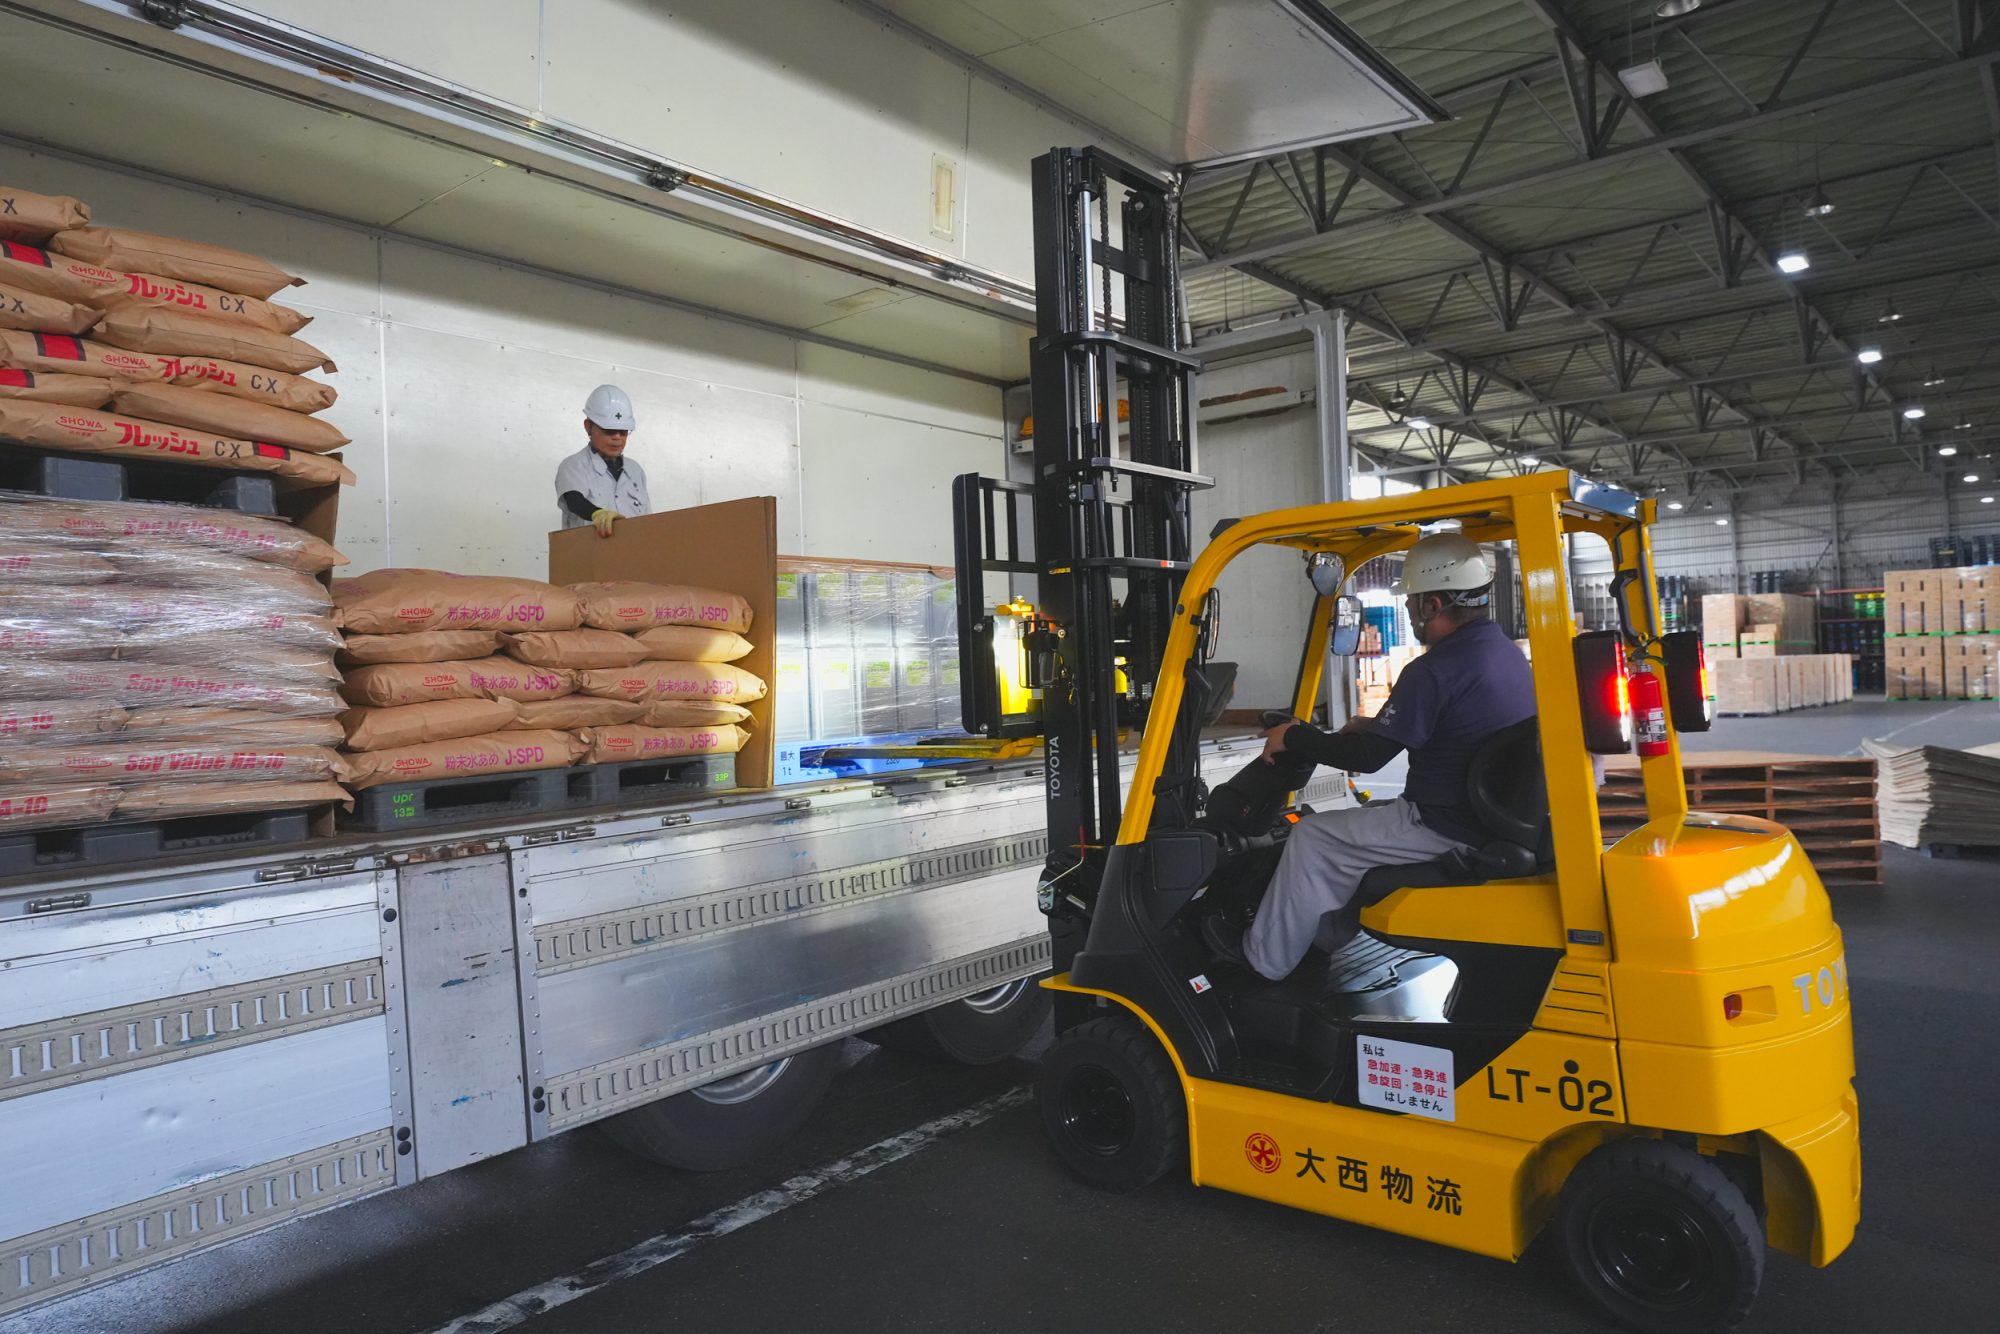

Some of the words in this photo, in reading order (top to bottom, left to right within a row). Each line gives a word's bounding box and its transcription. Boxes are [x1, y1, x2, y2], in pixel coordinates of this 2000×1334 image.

[71, 265, 113, 280] SHOWA
[123, 273, 208, 310] フレッシュ
[104, 354, 147, 366] SHOWA
[157, 357, 237, 387] フレッシュ
[59, 416, 104, 430] SHOWA
[114, 422, 201, 456] フレッシュ
[400, 607, 433, 616] SHOWA
[447, 605, 501, 621] 粉末水あめ
[506, 604, 545, 622] J-SPD
[618, 607, 643, 615] SHOWA
[699, 606, 728, 622] J-SPD
[424, 674, 456, 684] SHOWA
[703, 679, 734, 695] J-SPD
[689, 732, 718, 749] J-SPD
[125, 754, 164, 772] Soy
[168, 751, 226, 770] Value
[395, 757, 429, 767] SHOWA
[444, 752, 499, 770] 粉末水あめ
[504, 746, 545, 766] J-SPD
[1050, 735, 1060, 800] TOYOTA
[1362, 1043, 1385, 1057] 私は
[1367, 1058, 1448, 1084] 急加速・急発進
[1367, 1073, 1449, 1099] 急旋回・急停止
[1487, 1065, 1615, 1117] LT-02
[1384, 1090, 1444, 1112] はしません
[1294, 1147, 1463, 1217] 大西物流
